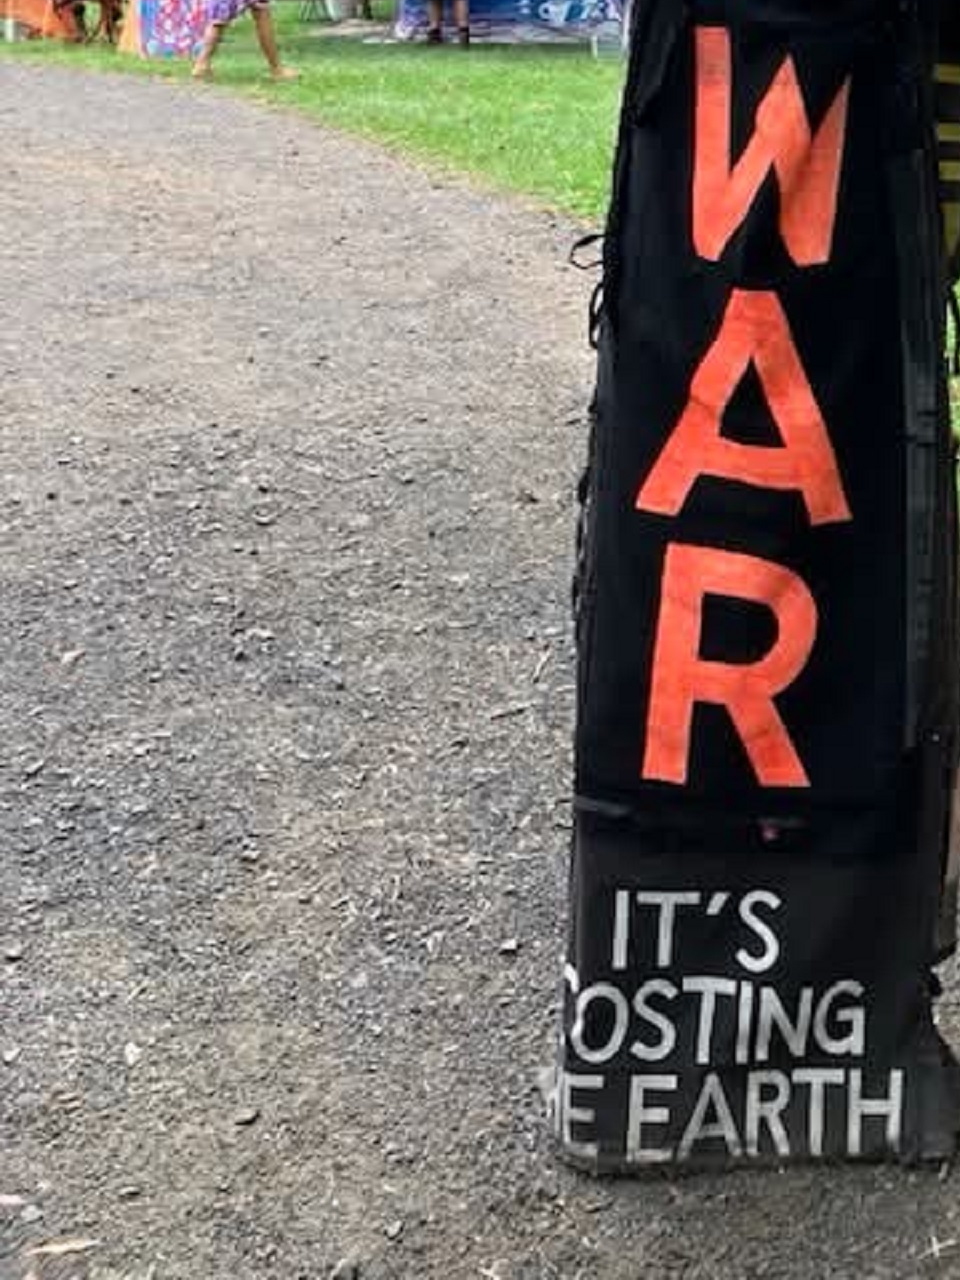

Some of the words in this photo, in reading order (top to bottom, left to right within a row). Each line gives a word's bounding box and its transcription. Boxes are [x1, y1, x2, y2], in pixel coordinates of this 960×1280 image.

[635, 25, 852, 788] WAR
[612, 890, 782, 973] IT'S
[564, 964, 867, 1065] OSTING
[626, 1068, 903, 1163] EARTH
